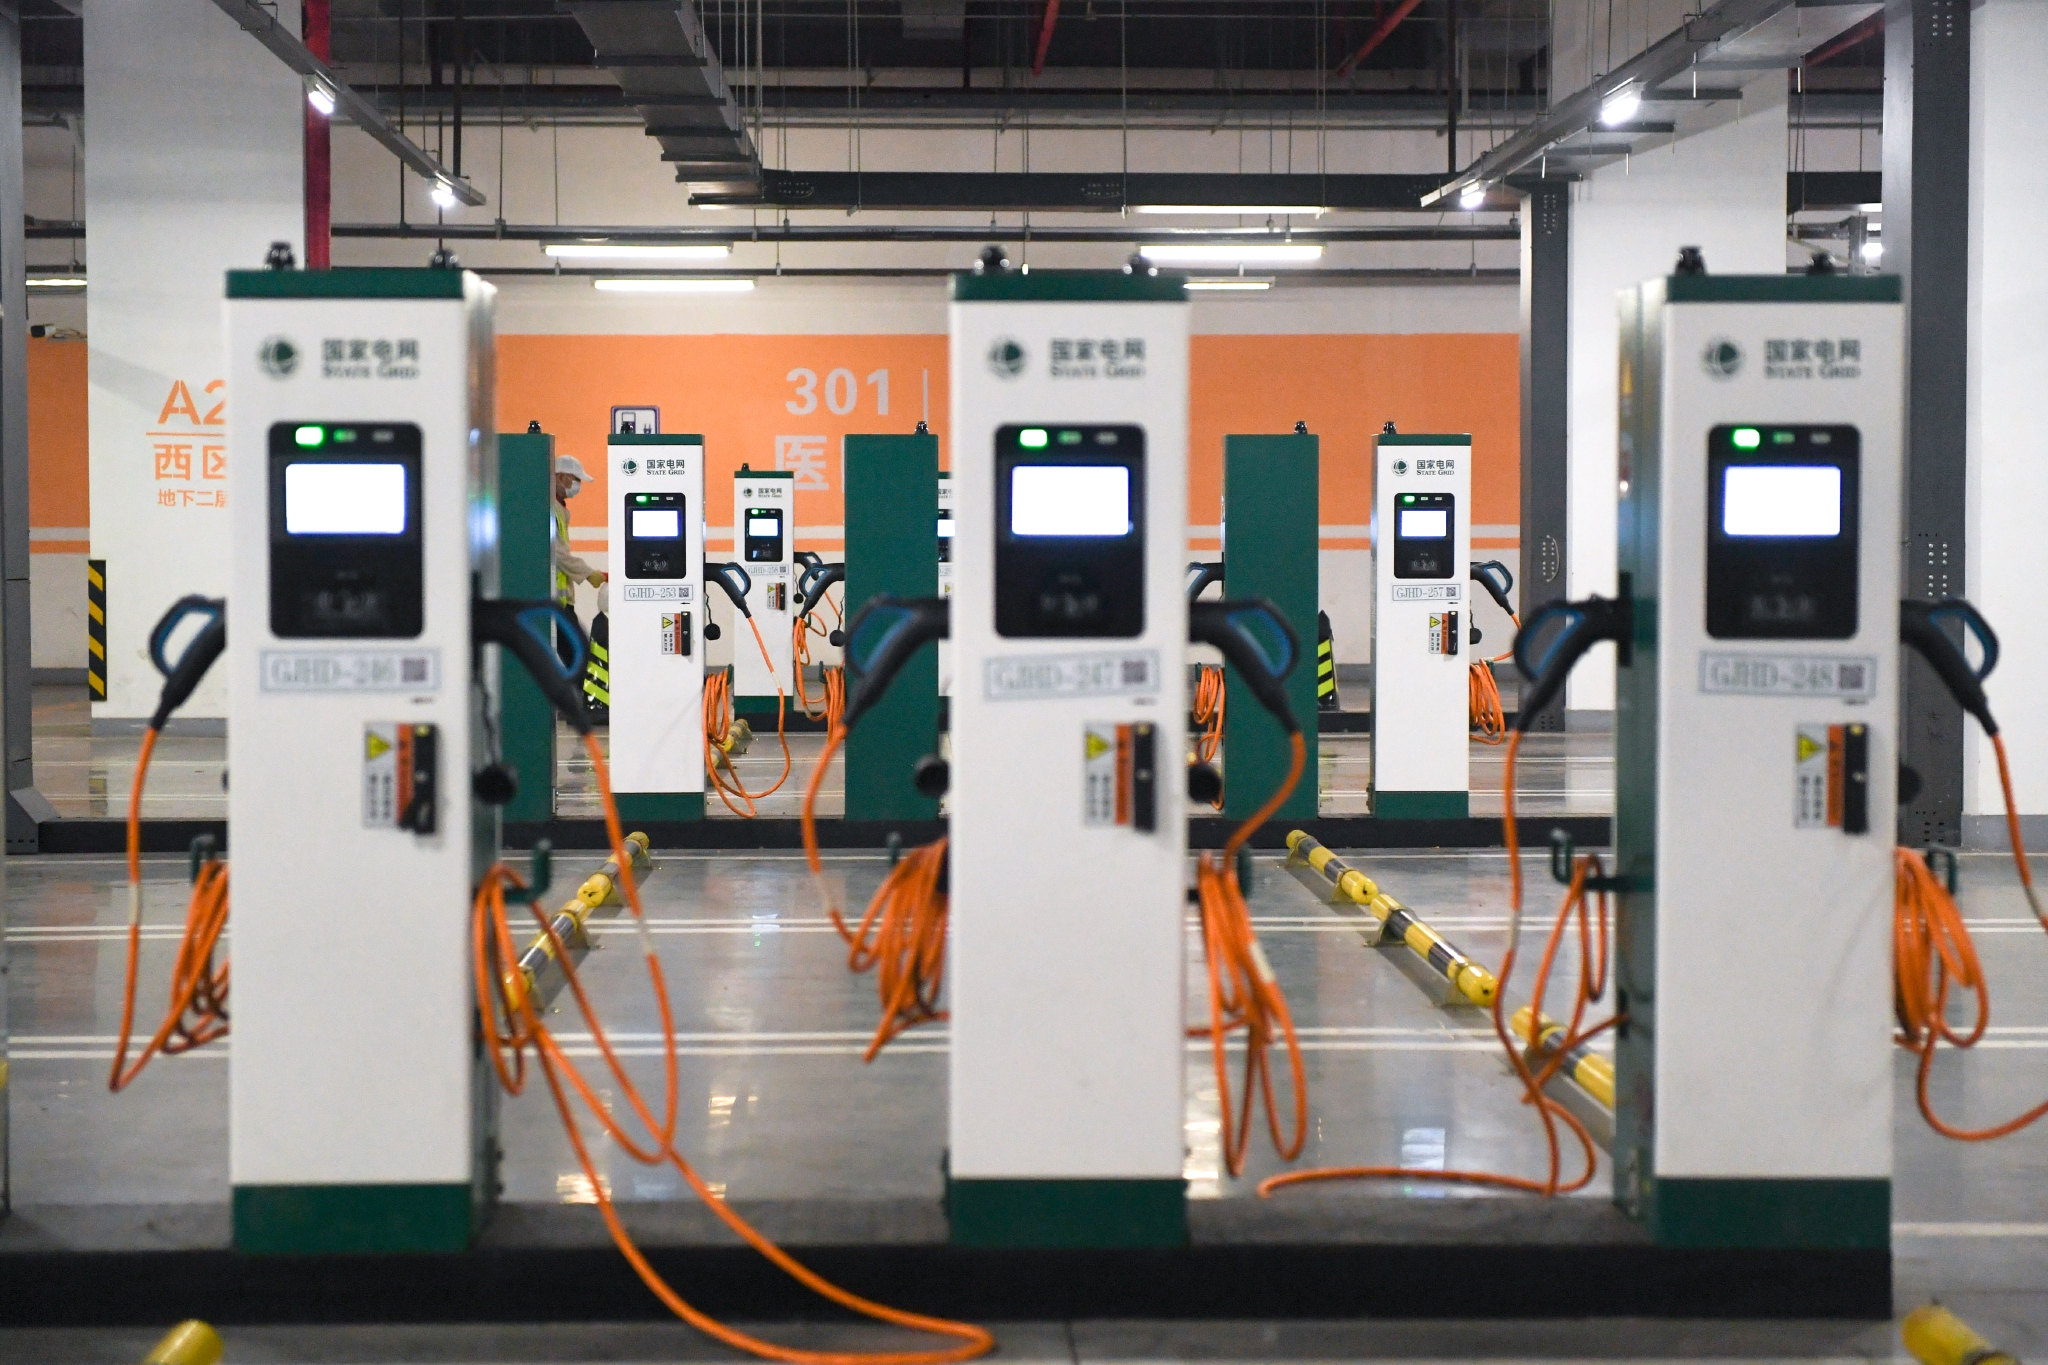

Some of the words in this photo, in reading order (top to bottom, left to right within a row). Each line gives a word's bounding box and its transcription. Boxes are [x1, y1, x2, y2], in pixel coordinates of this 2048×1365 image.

[323, 338, 418, 361] 国家电网
[1051, 338, 1146, 361] 国家电网
[1765, 339, 1861, 362] 国家电网
[157, 380, 226, 425] A2
[785, 368, 889, 415] 301
[153, 444, 227, 480] 西区
[646, 459, 685, 470] 国家电网
[775, 435, 845, 491] 医
[1416, 459, 1455, 470] 国家电网
[628, 587, 677, 598] GJHD-253
[1396, 586, 1444, 598] GJHD-257
